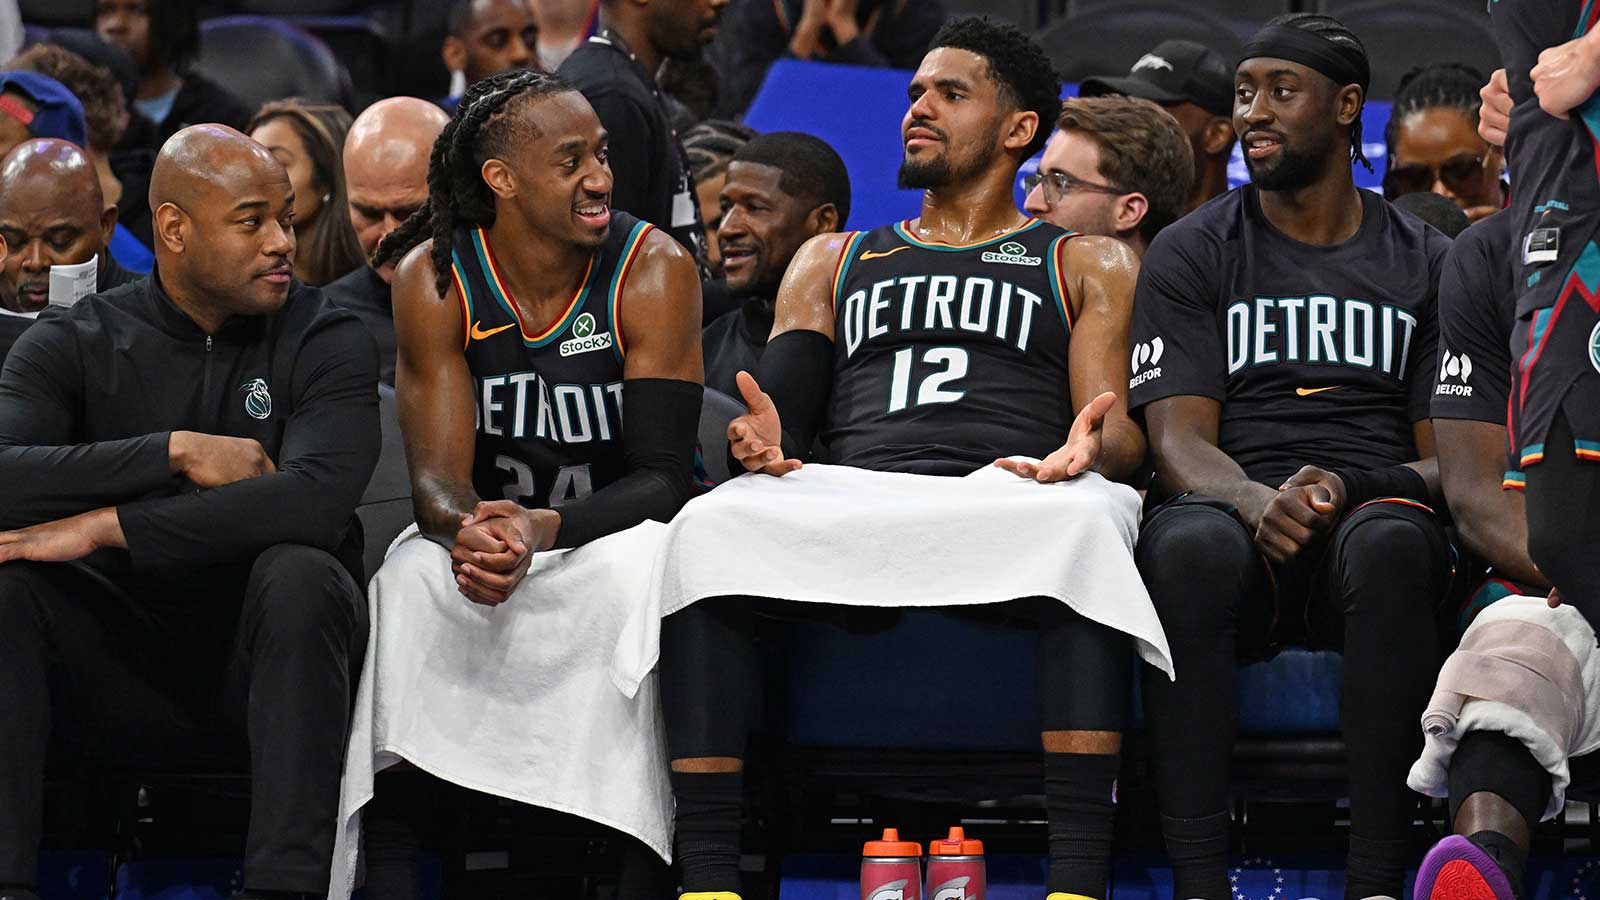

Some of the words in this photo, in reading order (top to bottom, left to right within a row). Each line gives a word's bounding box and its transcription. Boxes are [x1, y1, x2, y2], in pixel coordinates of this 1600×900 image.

[983, 252, 1040, 264] StockX
[844, 274, 1043, 358] DETROIT
[1226, 295, 1418, 381] DETROIT
[561, 333, 612, 354] StockX
[887, 346, 970, 415] 12
[1129, 367, 1162, 389] BELFOR
[1435, 383, 1473, 397] BELFOR
[475, 371, 625, 445] ETROIT
